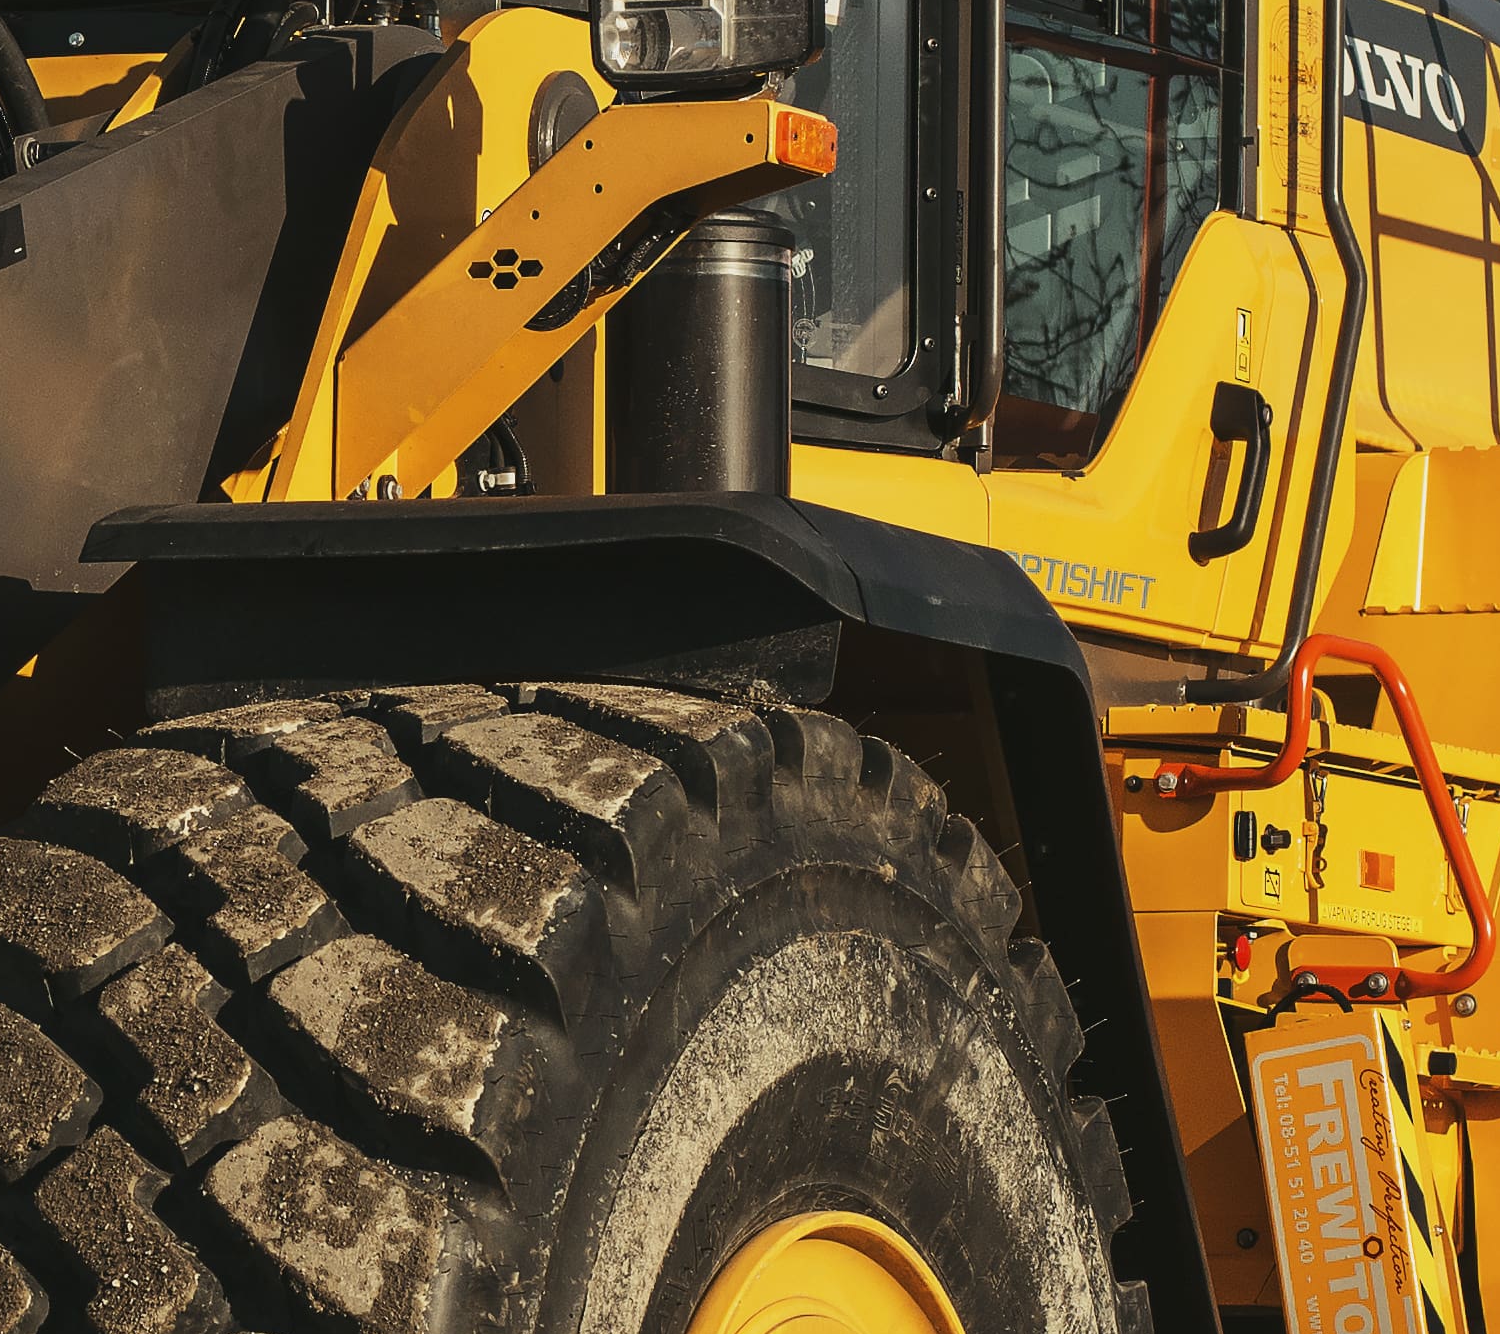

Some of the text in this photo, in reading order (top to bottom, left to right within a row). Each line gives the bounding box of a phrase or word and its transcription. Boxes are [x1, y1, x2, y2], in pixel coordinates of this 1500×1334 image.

[1344, 35, 1466, 133] LVO
[1272, 1073, 1293, 1110] Tel:
[1279, 1113, 1301, 1169] 08-51
[1288, 1177, 1304, 1200] 51
[1359, 1068, 1409, 1294] Creating Perfection
[1292, 1208, 1310, 1233] 20
[1298, 1239, 1315, 1264] 40
